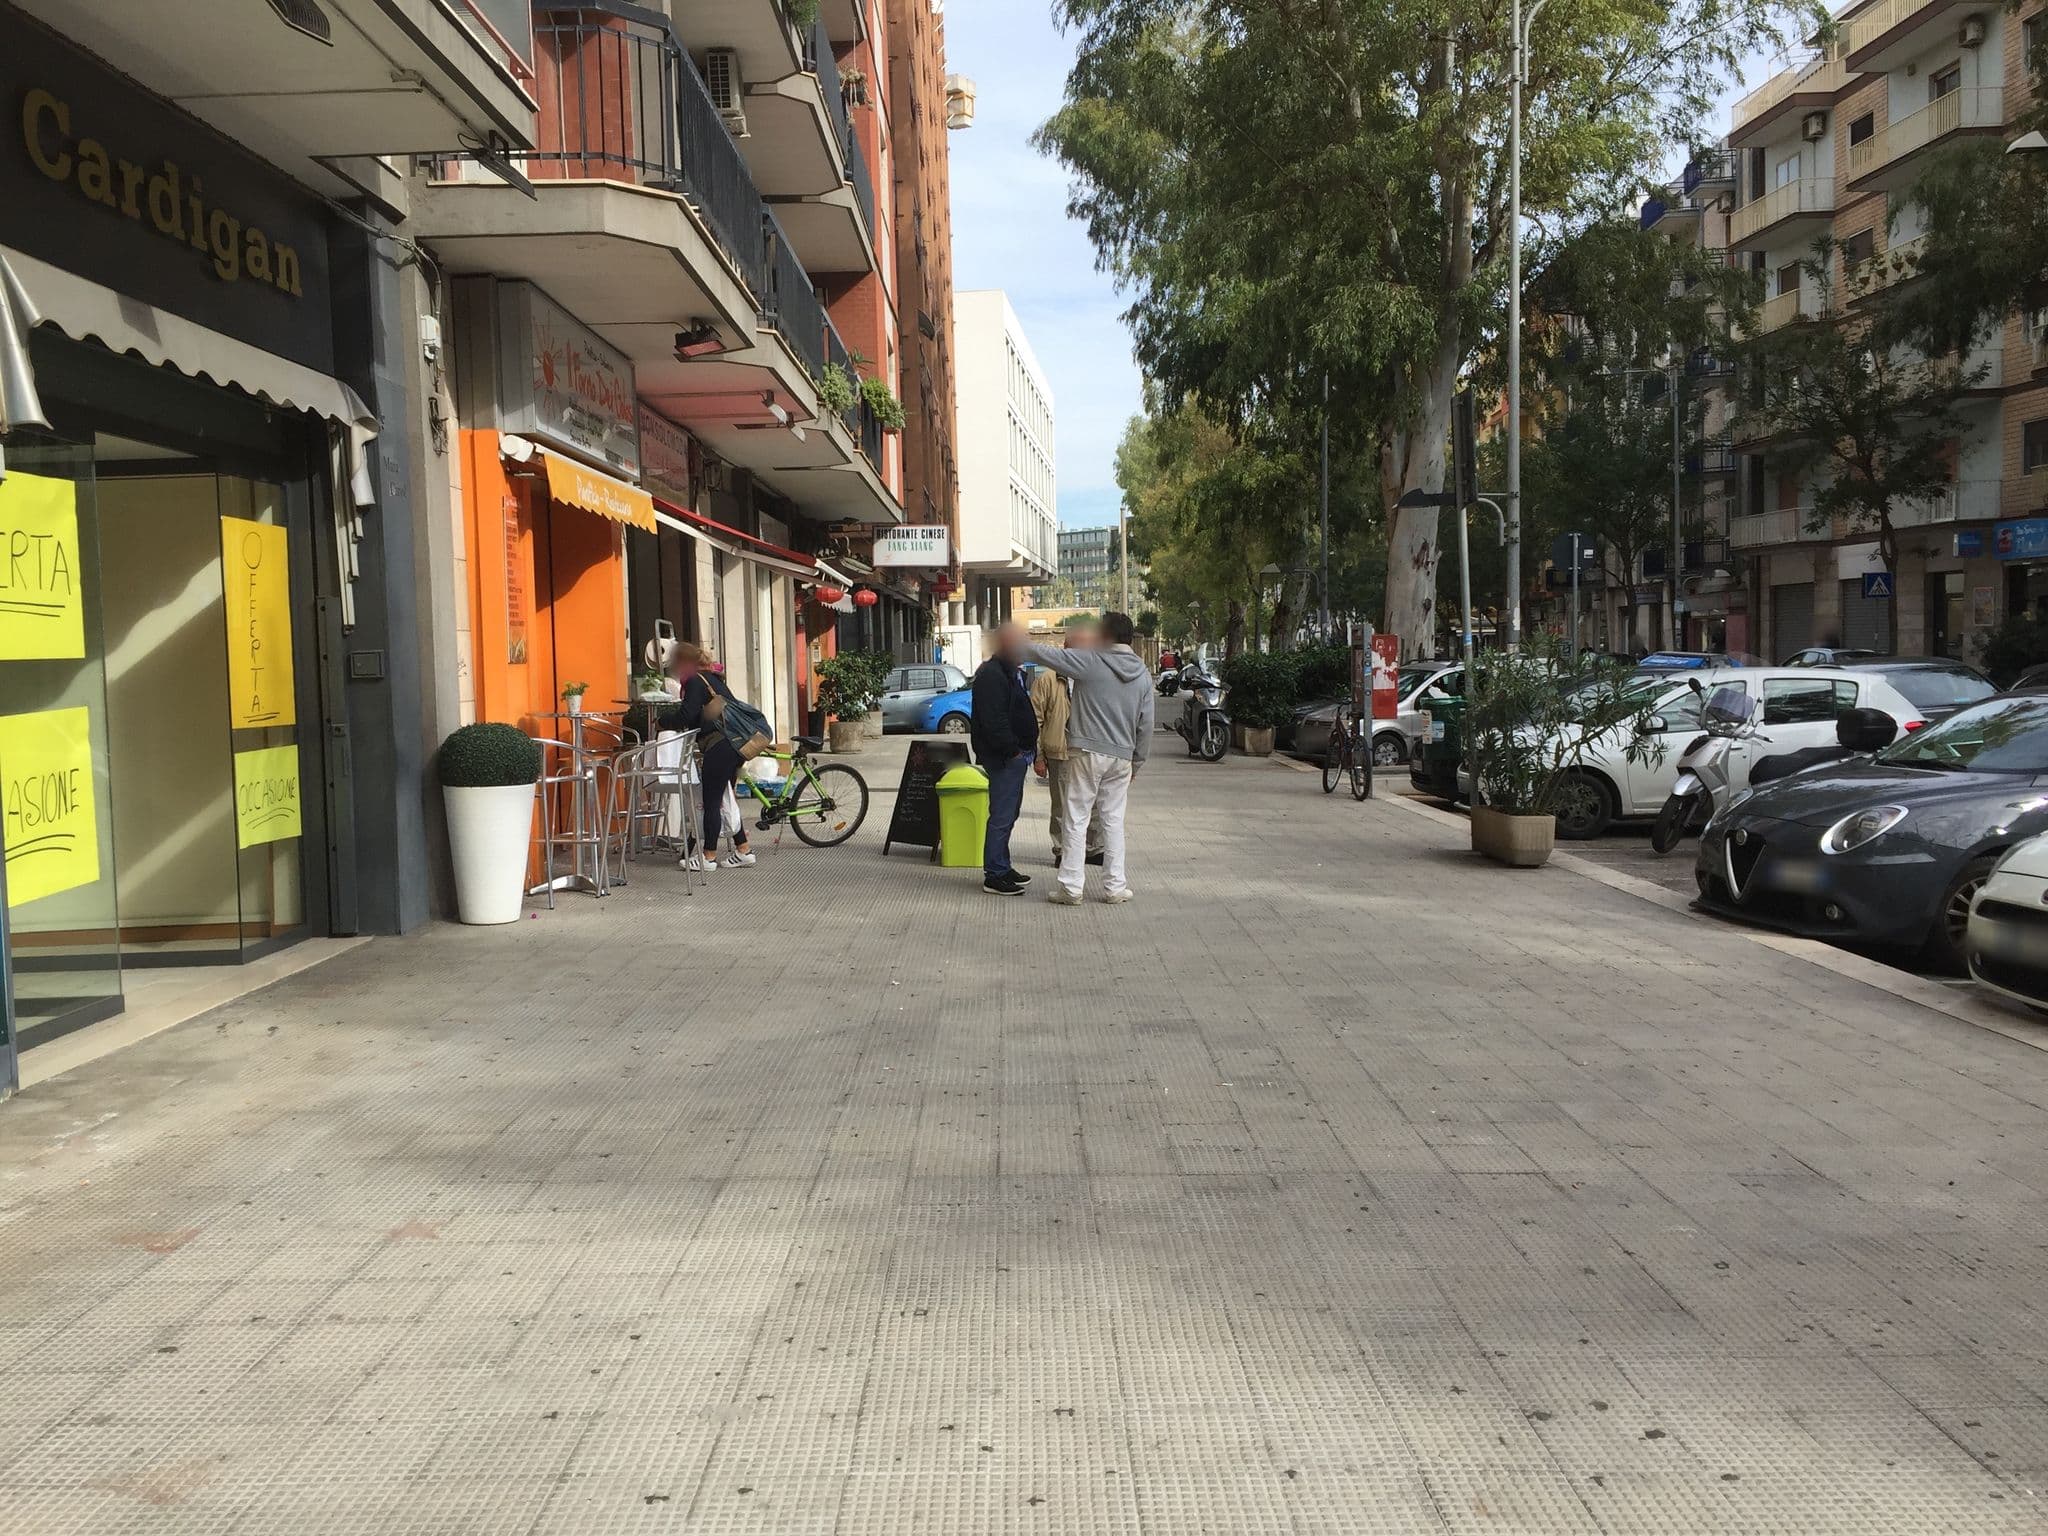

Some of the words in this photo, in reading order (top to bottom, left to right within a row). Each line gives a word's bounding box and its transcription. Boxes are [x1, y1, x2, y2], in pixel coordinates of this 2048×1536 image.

[22, 88, 303, 297] Cardigan
[876, 528, 918, 540] RISTORANTE
[921, 528, 945, 540] CINESE
[911, 540, 934, 552] XIANG
[239, 777, 296, 815] OCCASIONE
